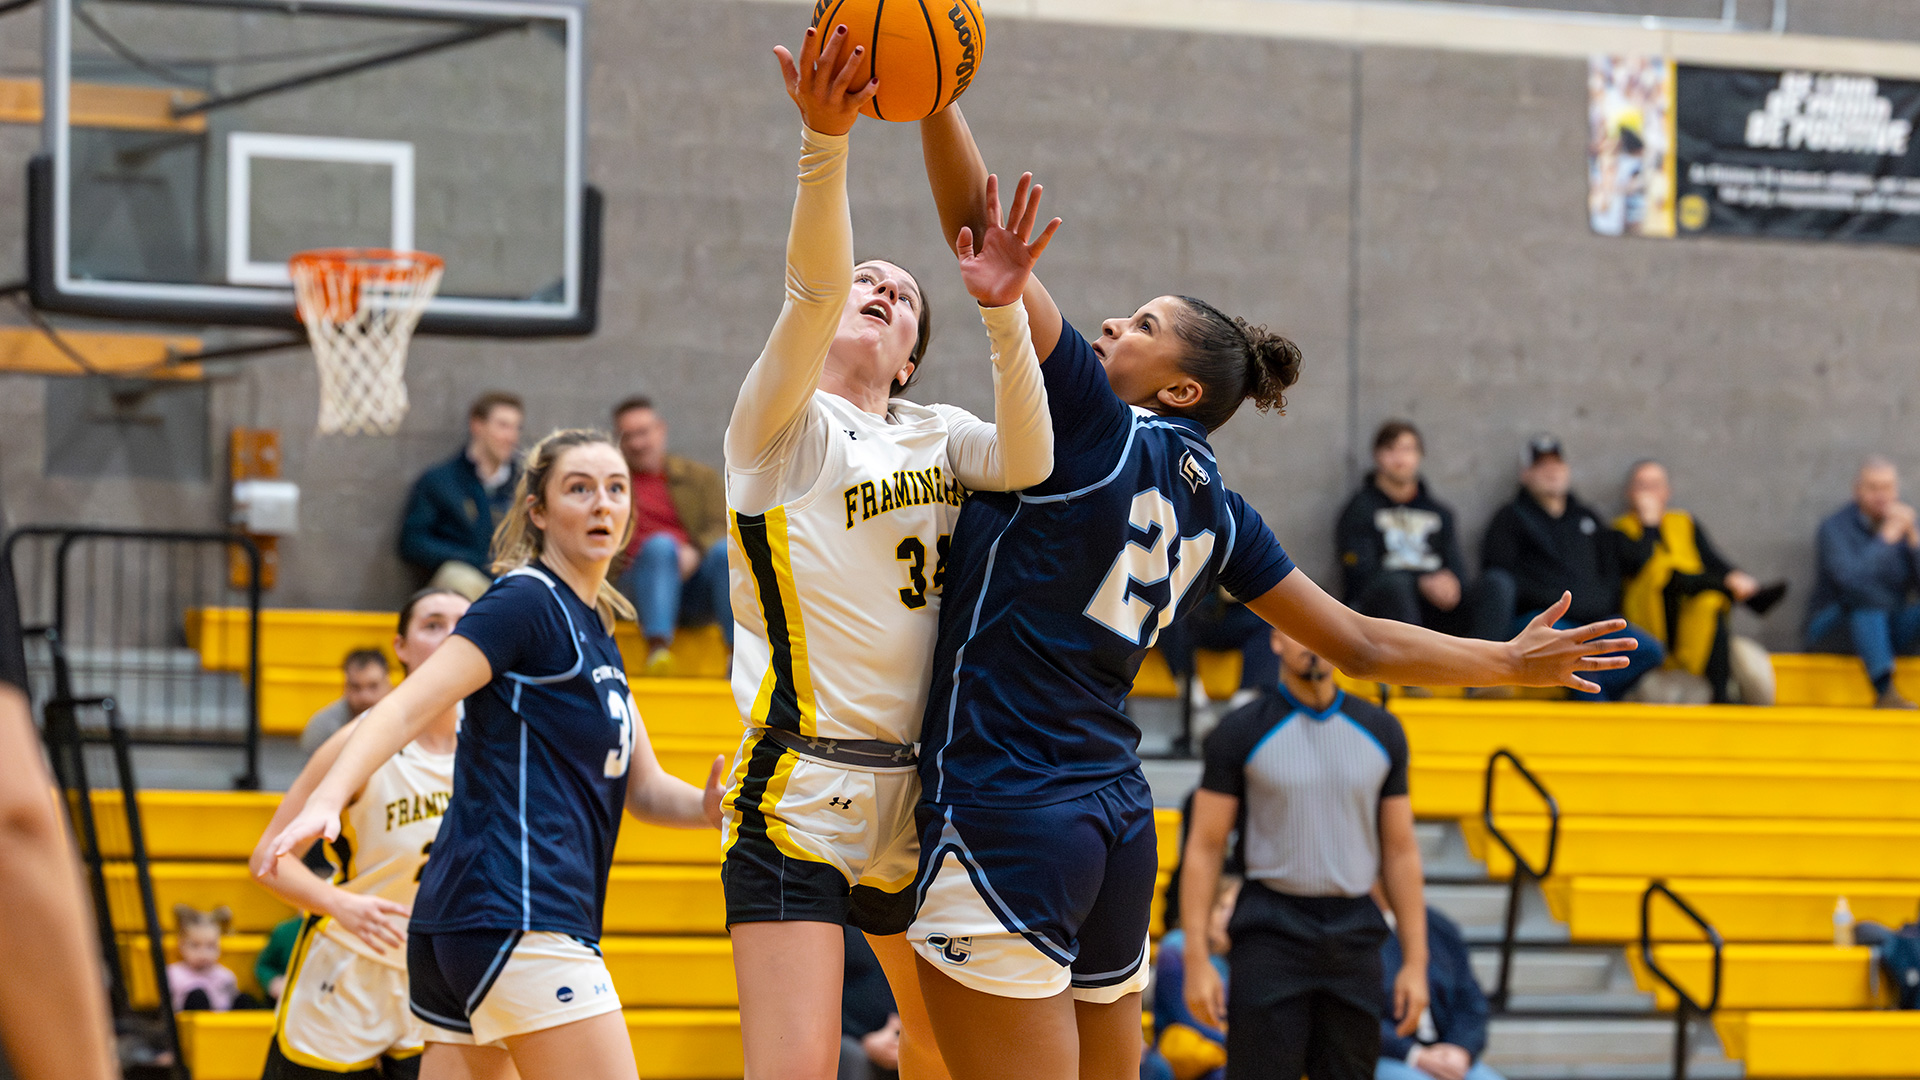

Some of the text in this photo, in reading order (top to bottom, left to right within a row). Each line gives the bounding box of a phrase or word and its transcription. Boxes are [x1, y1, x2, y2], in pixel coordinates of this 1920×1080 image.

[943, 3, 976, 109] Wilson
[1082, 486, 1216, 649] 21
[604, 690, 636, 779] 3
